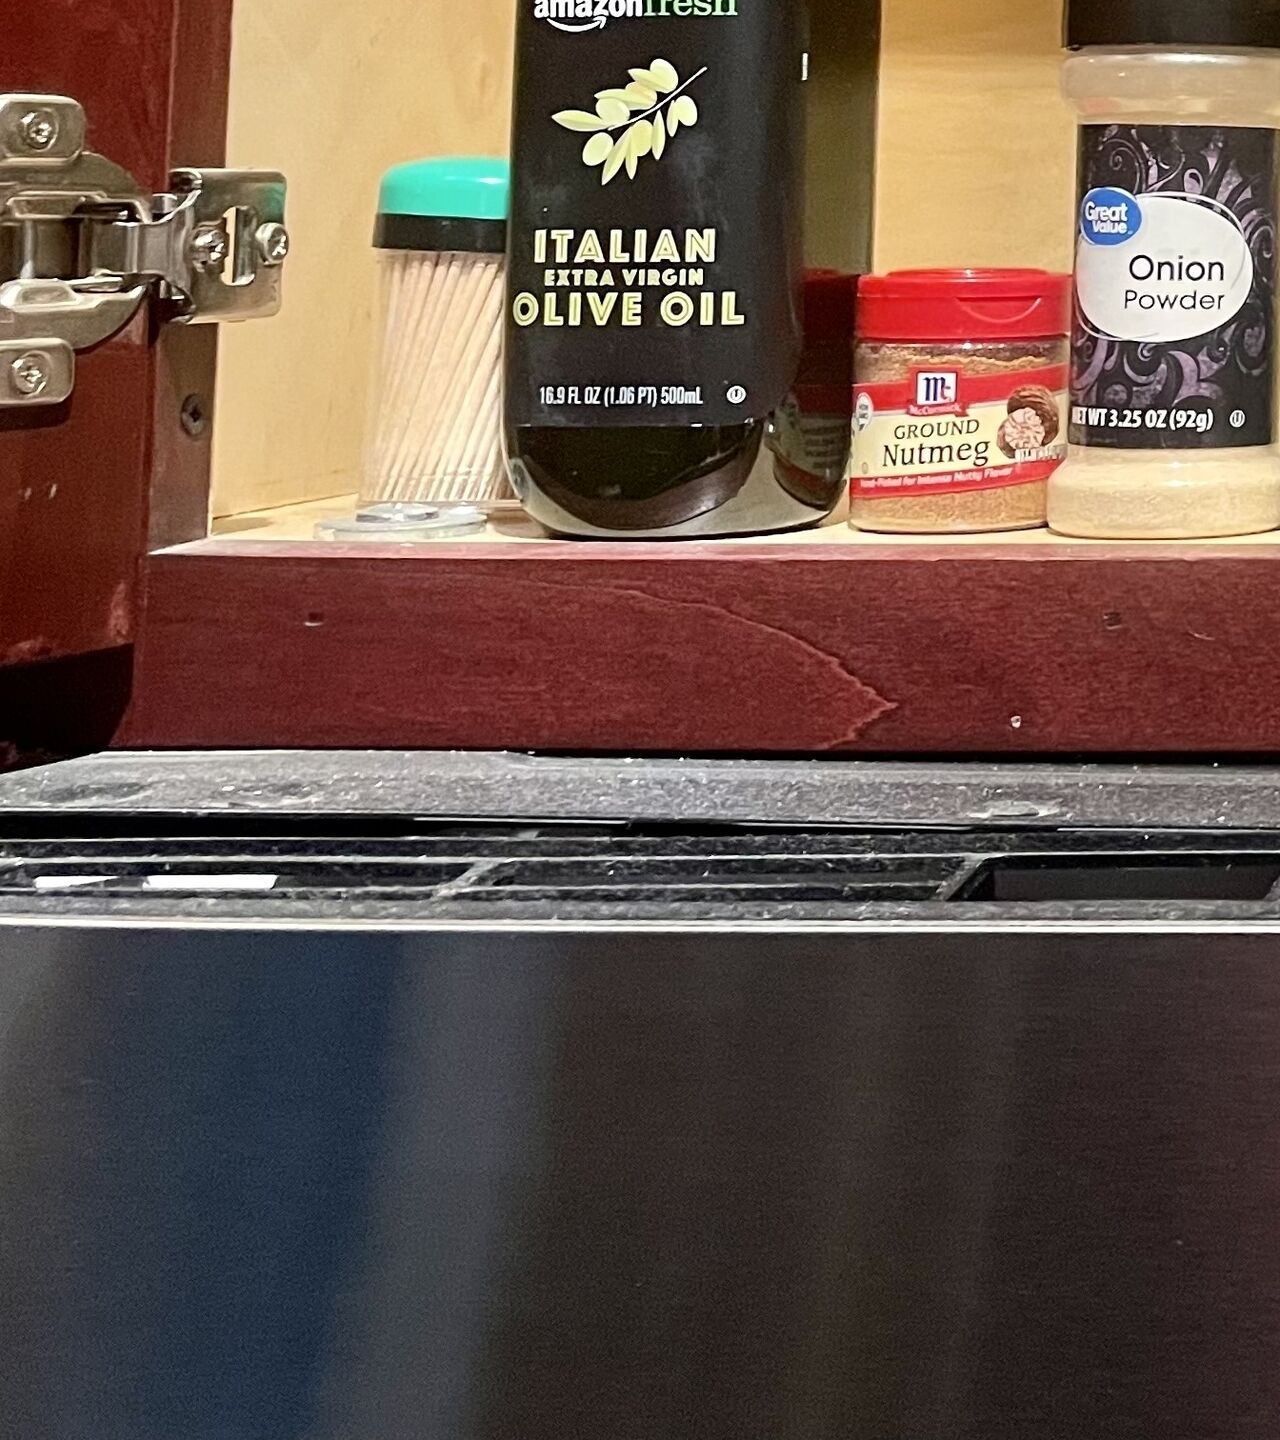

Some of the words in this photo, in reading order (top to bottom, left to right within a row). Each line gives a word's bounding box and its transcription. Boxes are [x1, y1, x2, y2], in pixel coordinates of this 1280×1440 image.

[1085, 200, 1128, 224] Great
[1092, 217, 1128, 235] Value
[534, 229, 716, 263] ITALIAN
[544, 268, 615, 286] EXTRA
[622, 268, 704, 286] VIRGIN
[1128, 254, 1225, 281] Onion
[512, 292, 643, 327] OLIVE
[660, 291, 745, 326] OIL
[1124, 291, 1226, 311] Powder
[540, 386, 565, 405] 16.9
[568, 387, 581, 404] FL
[584, 387, 601, 404] OZ
[603, 386, 635, 407] (1.06
[637, 386, 658, 407] PT)
[660, 386, 704, 405] 500mL
[894, 419, 979, 439] GROUND
[1072, 408, 1087, 426] NET
[1088, 408, 1107, 426] WT
[1108, 408, 1142, 427] 3.25
[1145, 409, 1167, 427] OZ
[1169, 409, 1214, 432] (92g)
[883, 440, 990, 467] Nutmeg
